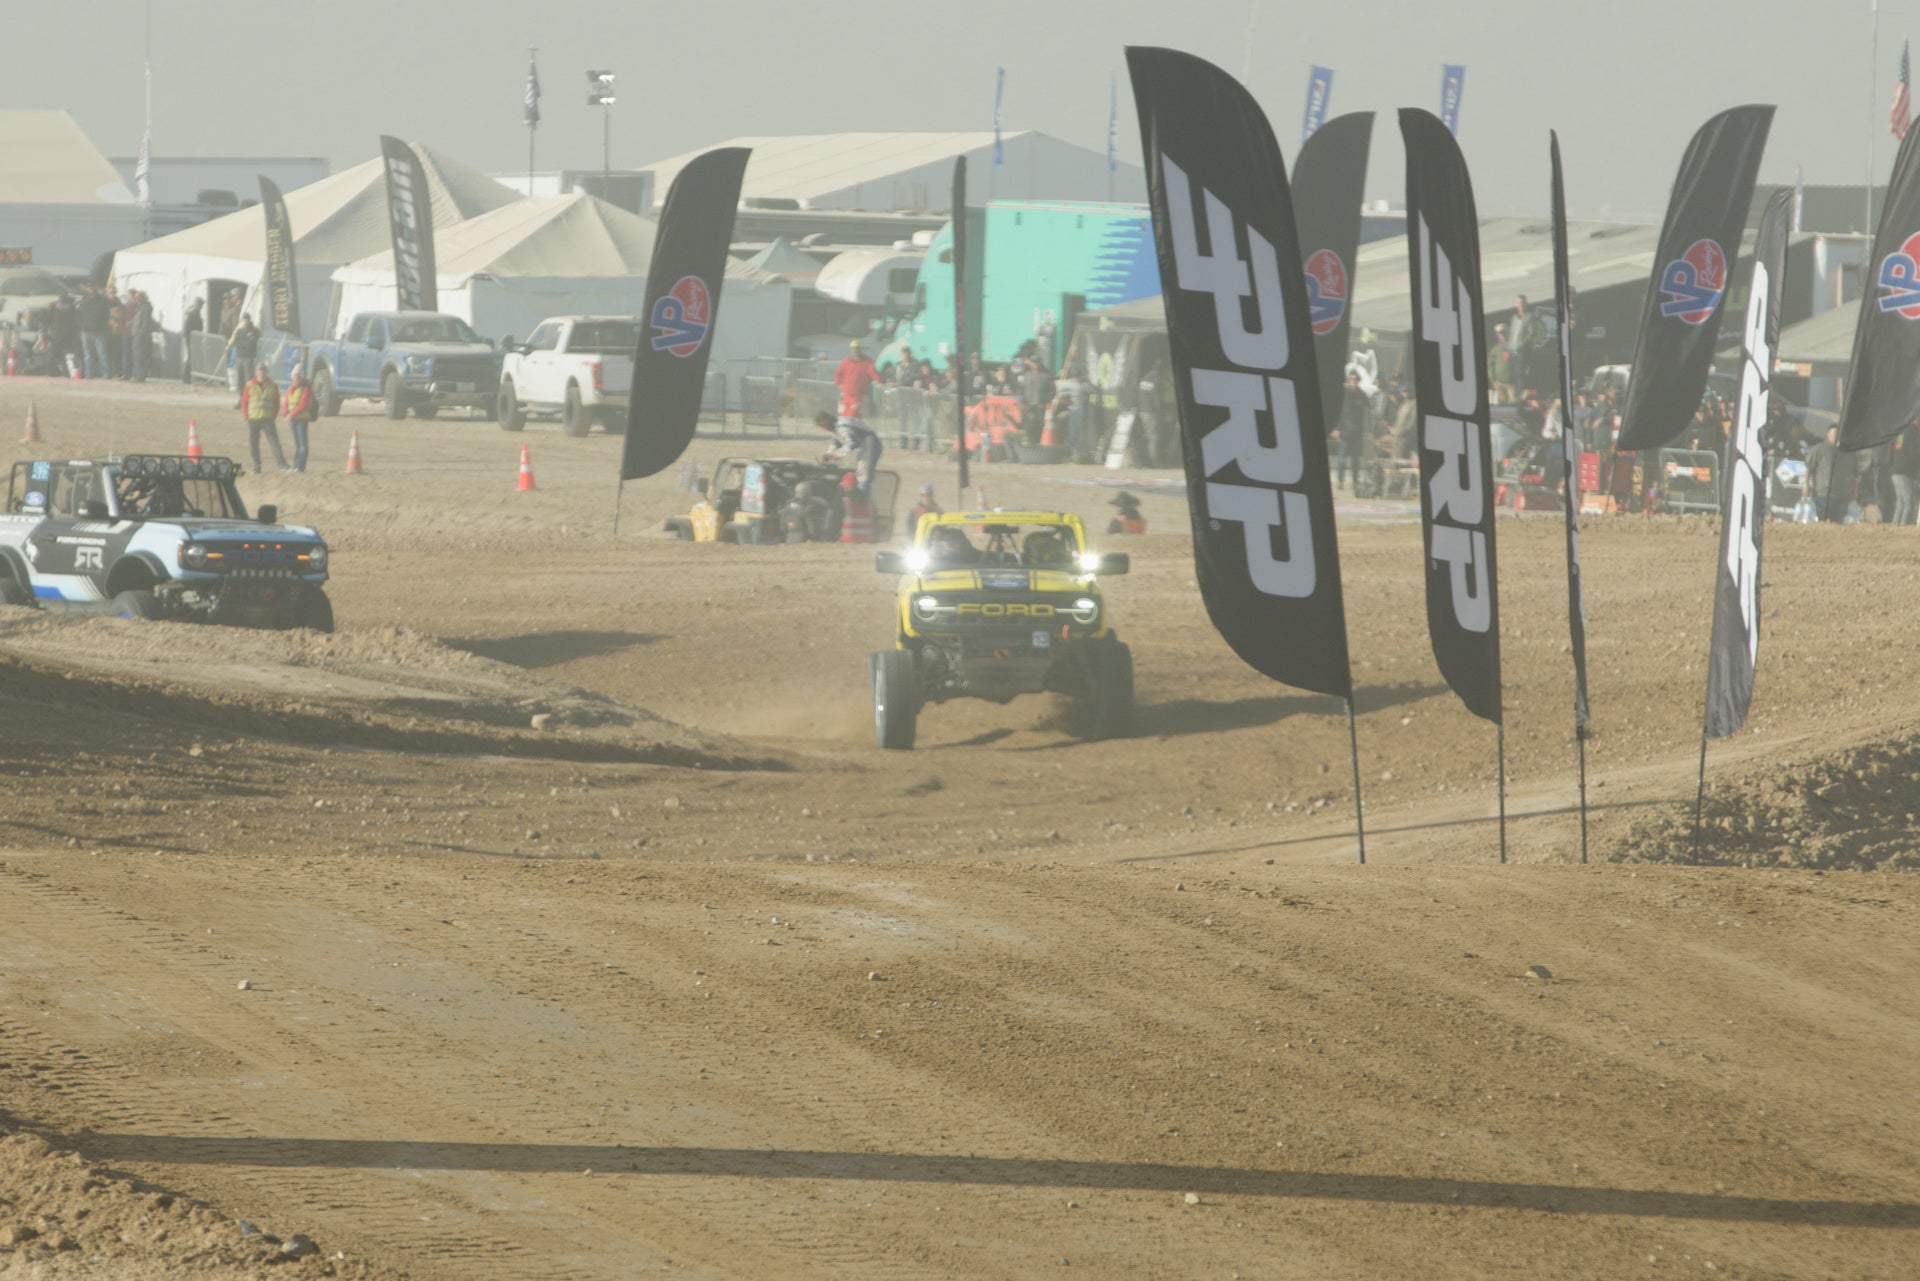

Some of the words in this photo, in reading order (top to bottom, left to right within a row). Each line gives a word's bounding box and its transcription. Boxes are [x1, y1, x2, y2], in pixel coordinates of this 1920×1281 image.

[267, 229, 286, 283] MADDEN
[1700, 240, 1720, 288] Racing
[274, 286, 289, 327] TERRY
[1660, 258, 1722, 318] VP
[651, 296, 708, 351] VP
[1160, 151, 1318, 600] PRP
[1417, 208, 1491, 633] PRP
[957, 603, 1054, 616] FORD
